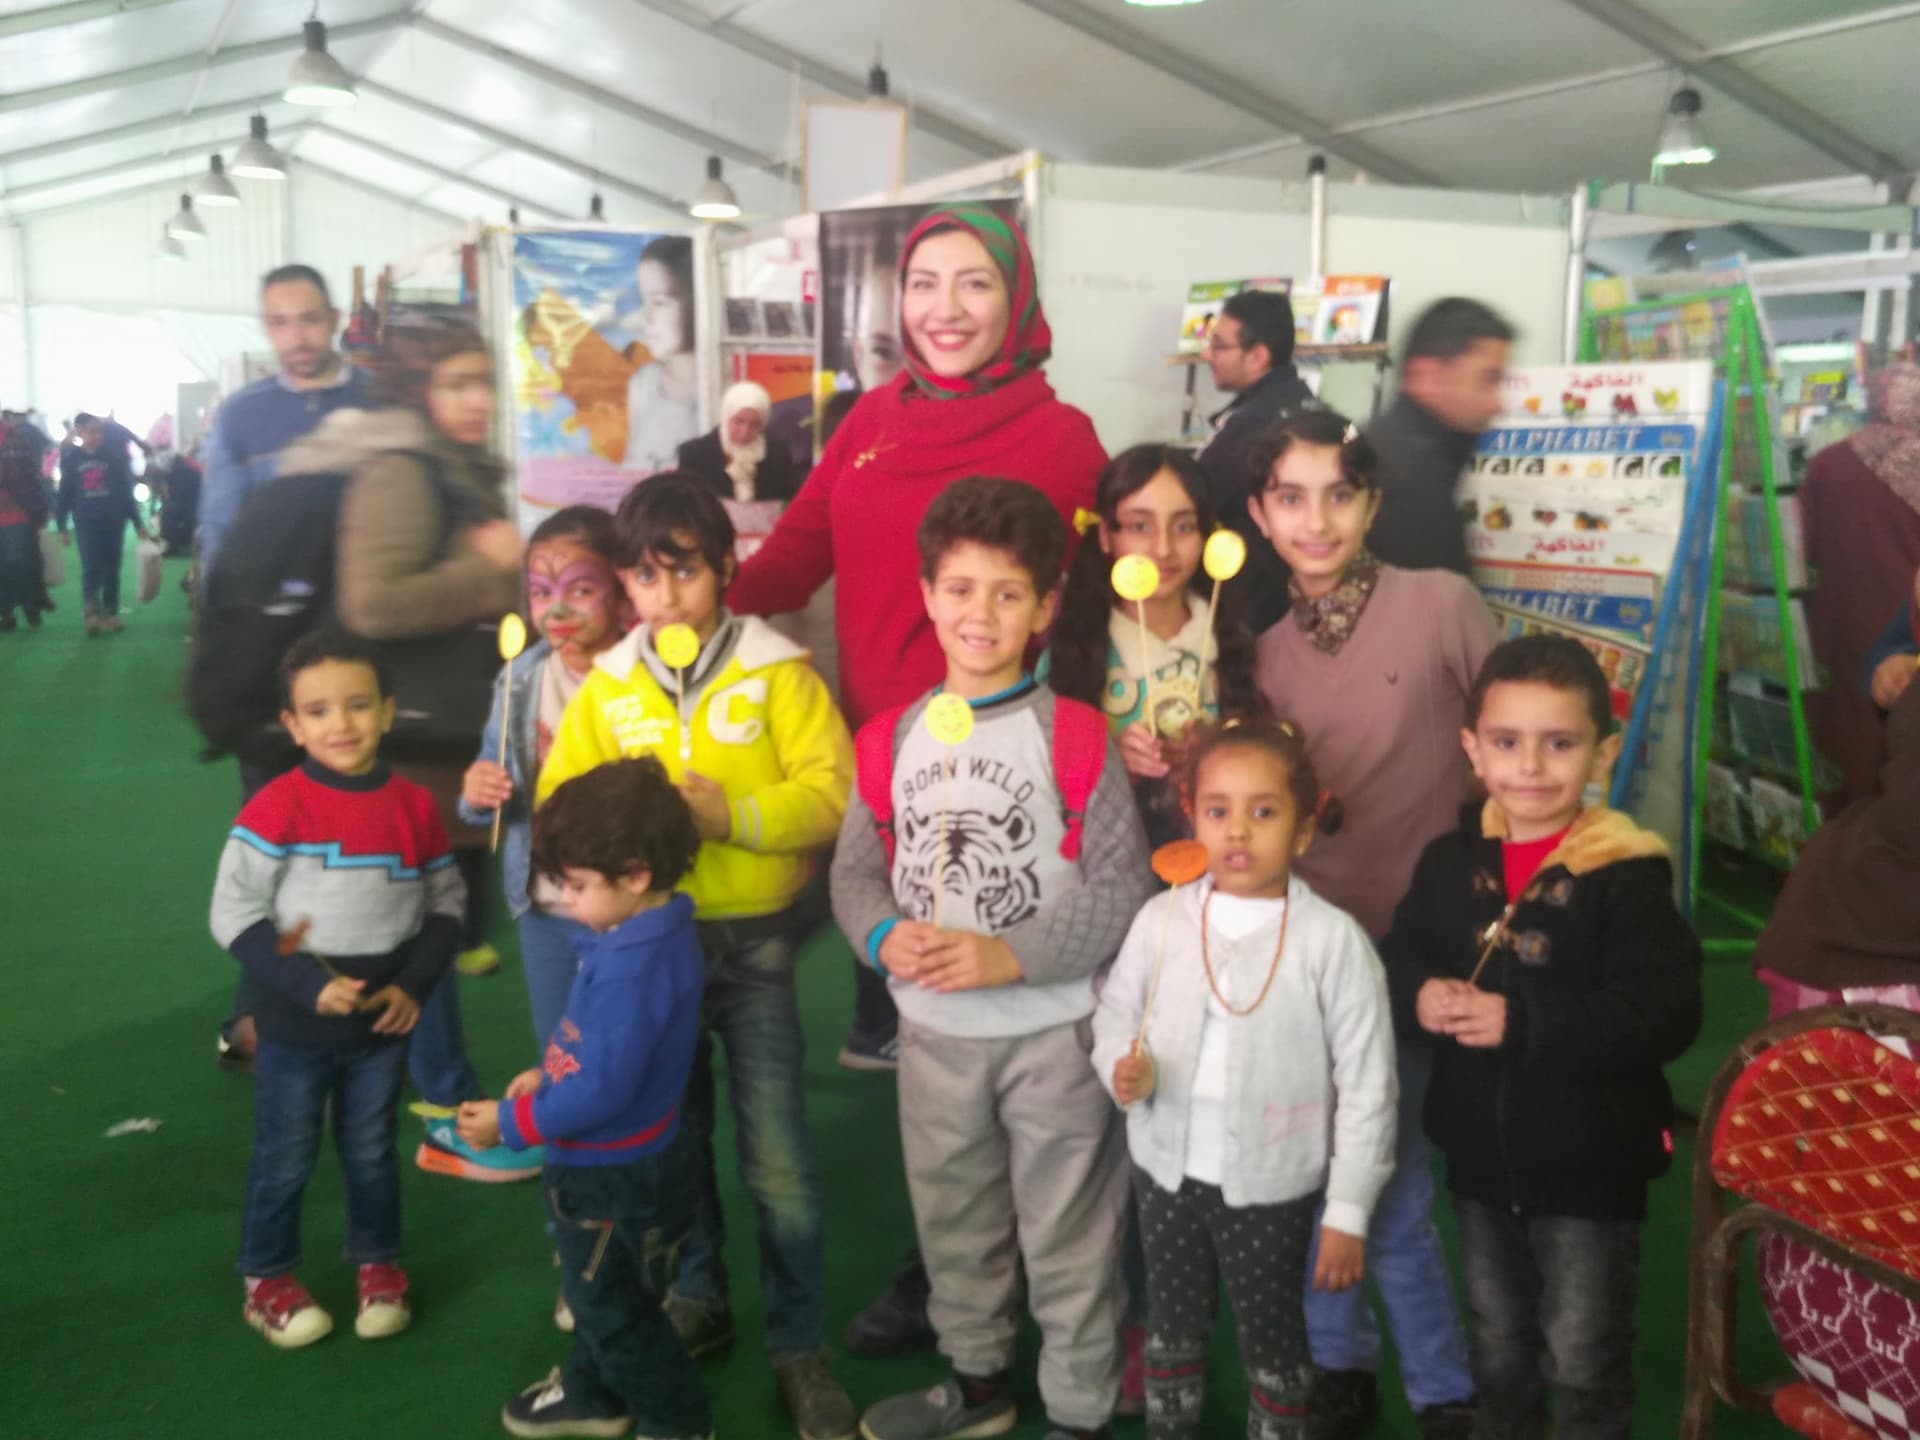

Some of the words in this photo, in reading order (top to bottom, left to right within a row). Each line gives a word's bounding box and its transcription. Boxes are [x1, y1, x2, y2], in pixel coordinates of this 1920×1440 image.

[1488, 428, 1641, 451] ALPHABET
[707, 678, 768, 744] C
[903, 757, 957, 800] BORN
[968, 755, 1034, 803] WILD
